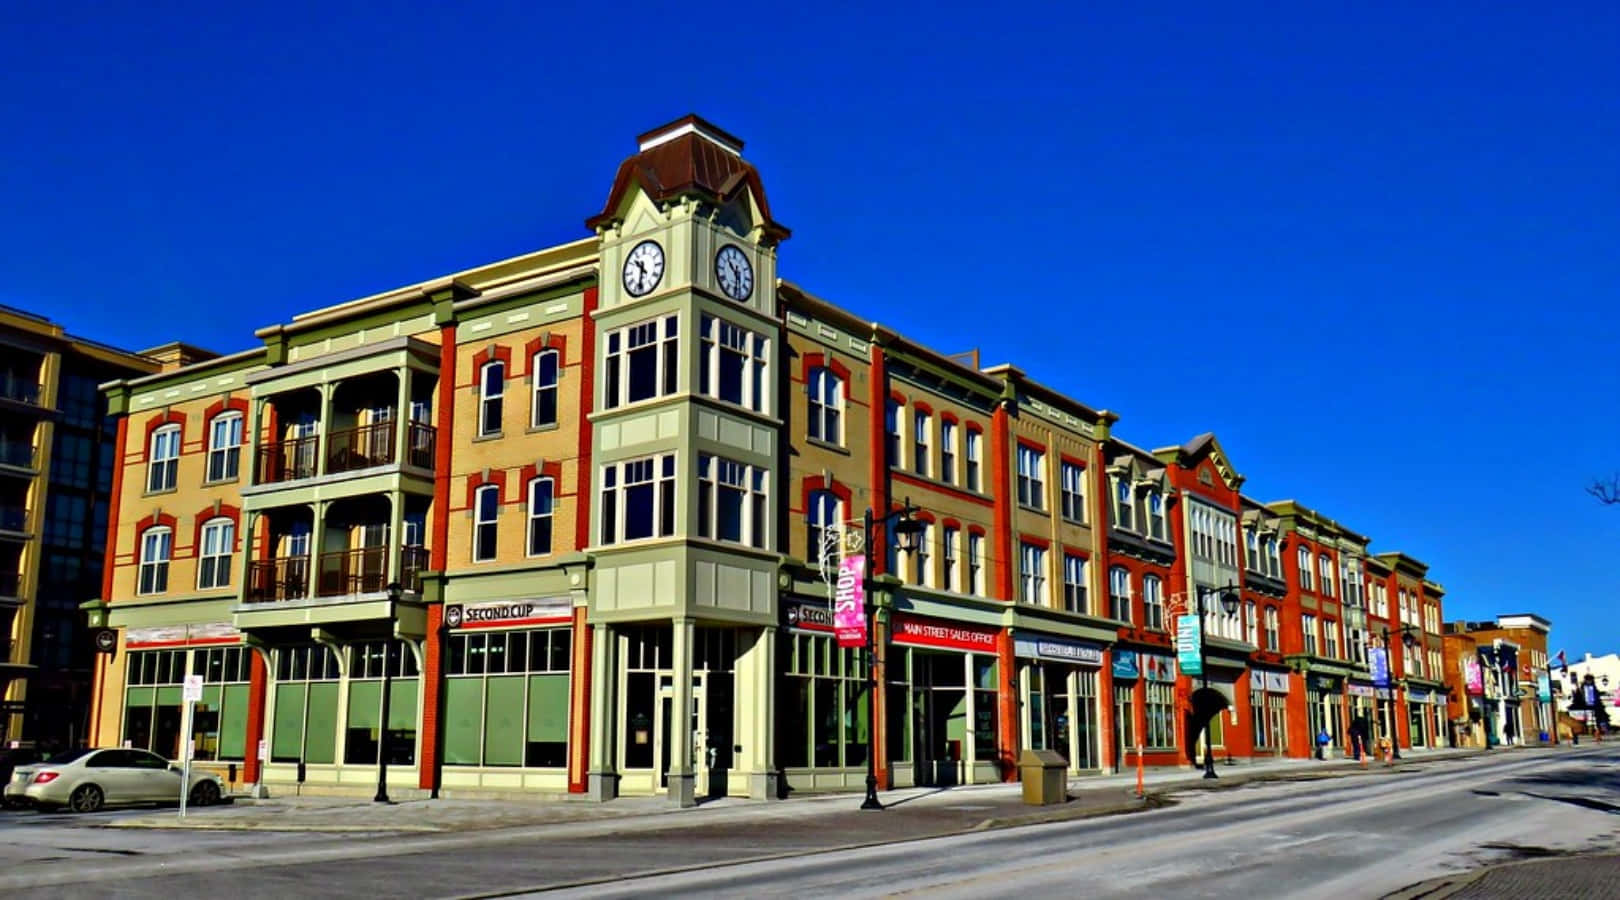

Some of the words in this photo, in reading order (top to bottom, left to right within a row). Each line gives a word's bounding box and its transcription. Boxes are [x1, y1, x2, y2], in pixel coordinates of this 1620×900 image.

[835, 566, 855, 613] SHOP
[466, 606, 509, 621] SECOND
[511, 604, 533, 618] CUP
[803, 608, 833, 625] SECON
[904, 623, 922, 635] MAIN
[923, 625, 949, 639] STREET
[950, 629, 971, 641] SALES
[971, 631, 993, 645] OFFICE
